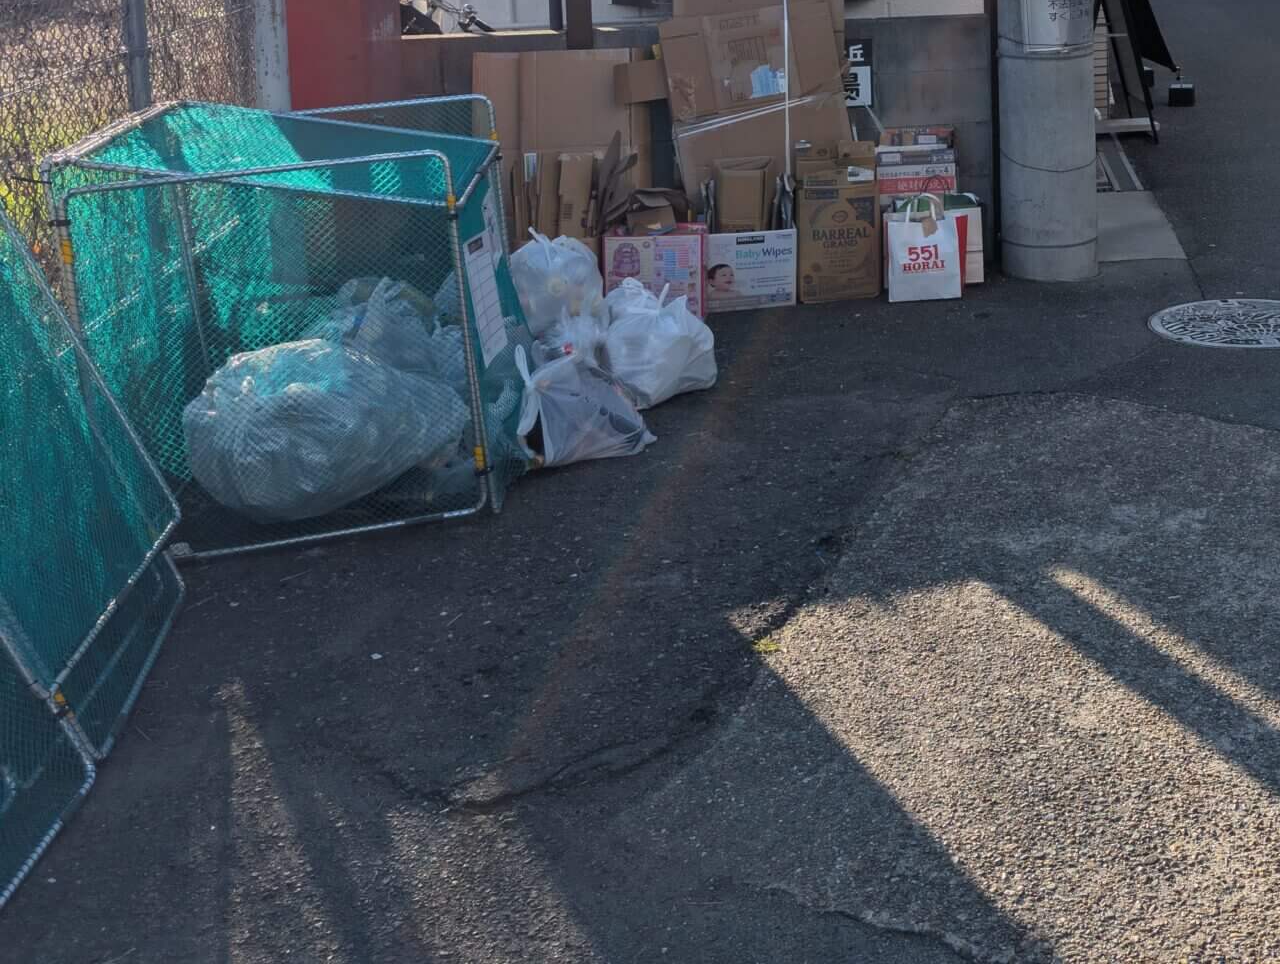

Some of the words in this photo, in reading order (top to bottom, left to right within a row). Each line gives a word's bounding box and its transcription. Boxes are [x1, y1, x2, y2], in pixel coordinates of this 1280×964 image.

[762, 245, 792, 258] Wipes
[908, 244, 939, 262] 551
[903, 259, 945, 272] HORAI
